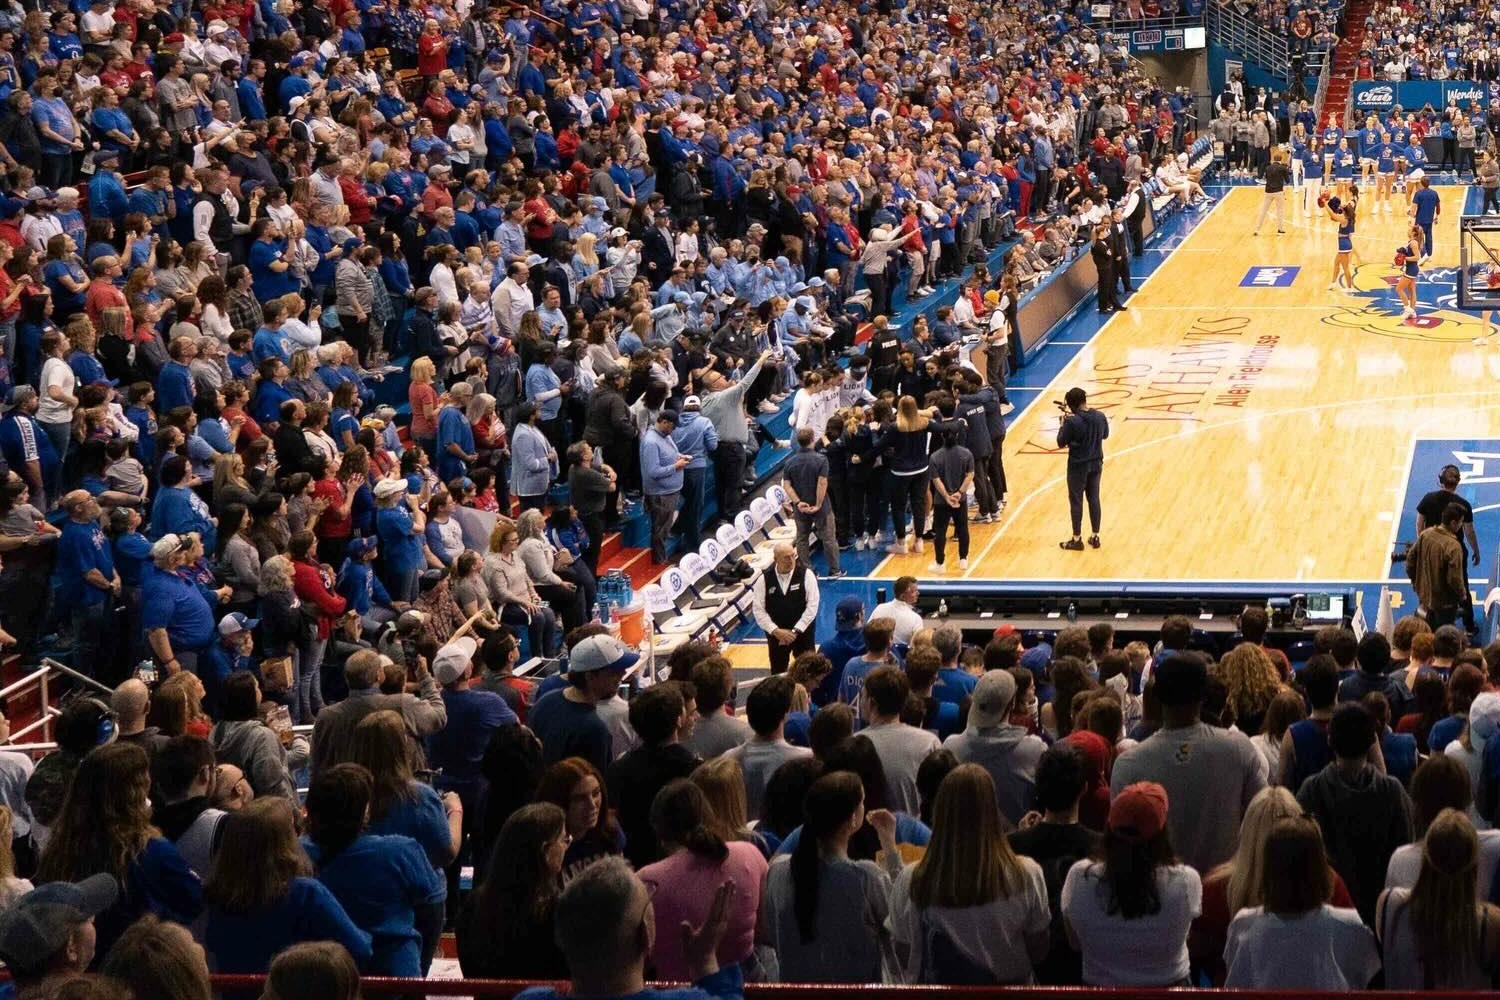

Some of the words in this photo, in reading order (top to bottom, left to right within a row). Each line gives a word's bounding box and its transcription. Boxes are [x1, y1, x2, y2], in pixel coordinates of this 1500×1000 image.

[1357, 91, 1393, 102] Club
[1447, 87, 1483, 100] Wendy's
[1124, 316, 1251, 422] JAYHAWKS
[1213, 383, 1256, 408] Allen
[1014, 363, 1152, 456] KSAS
